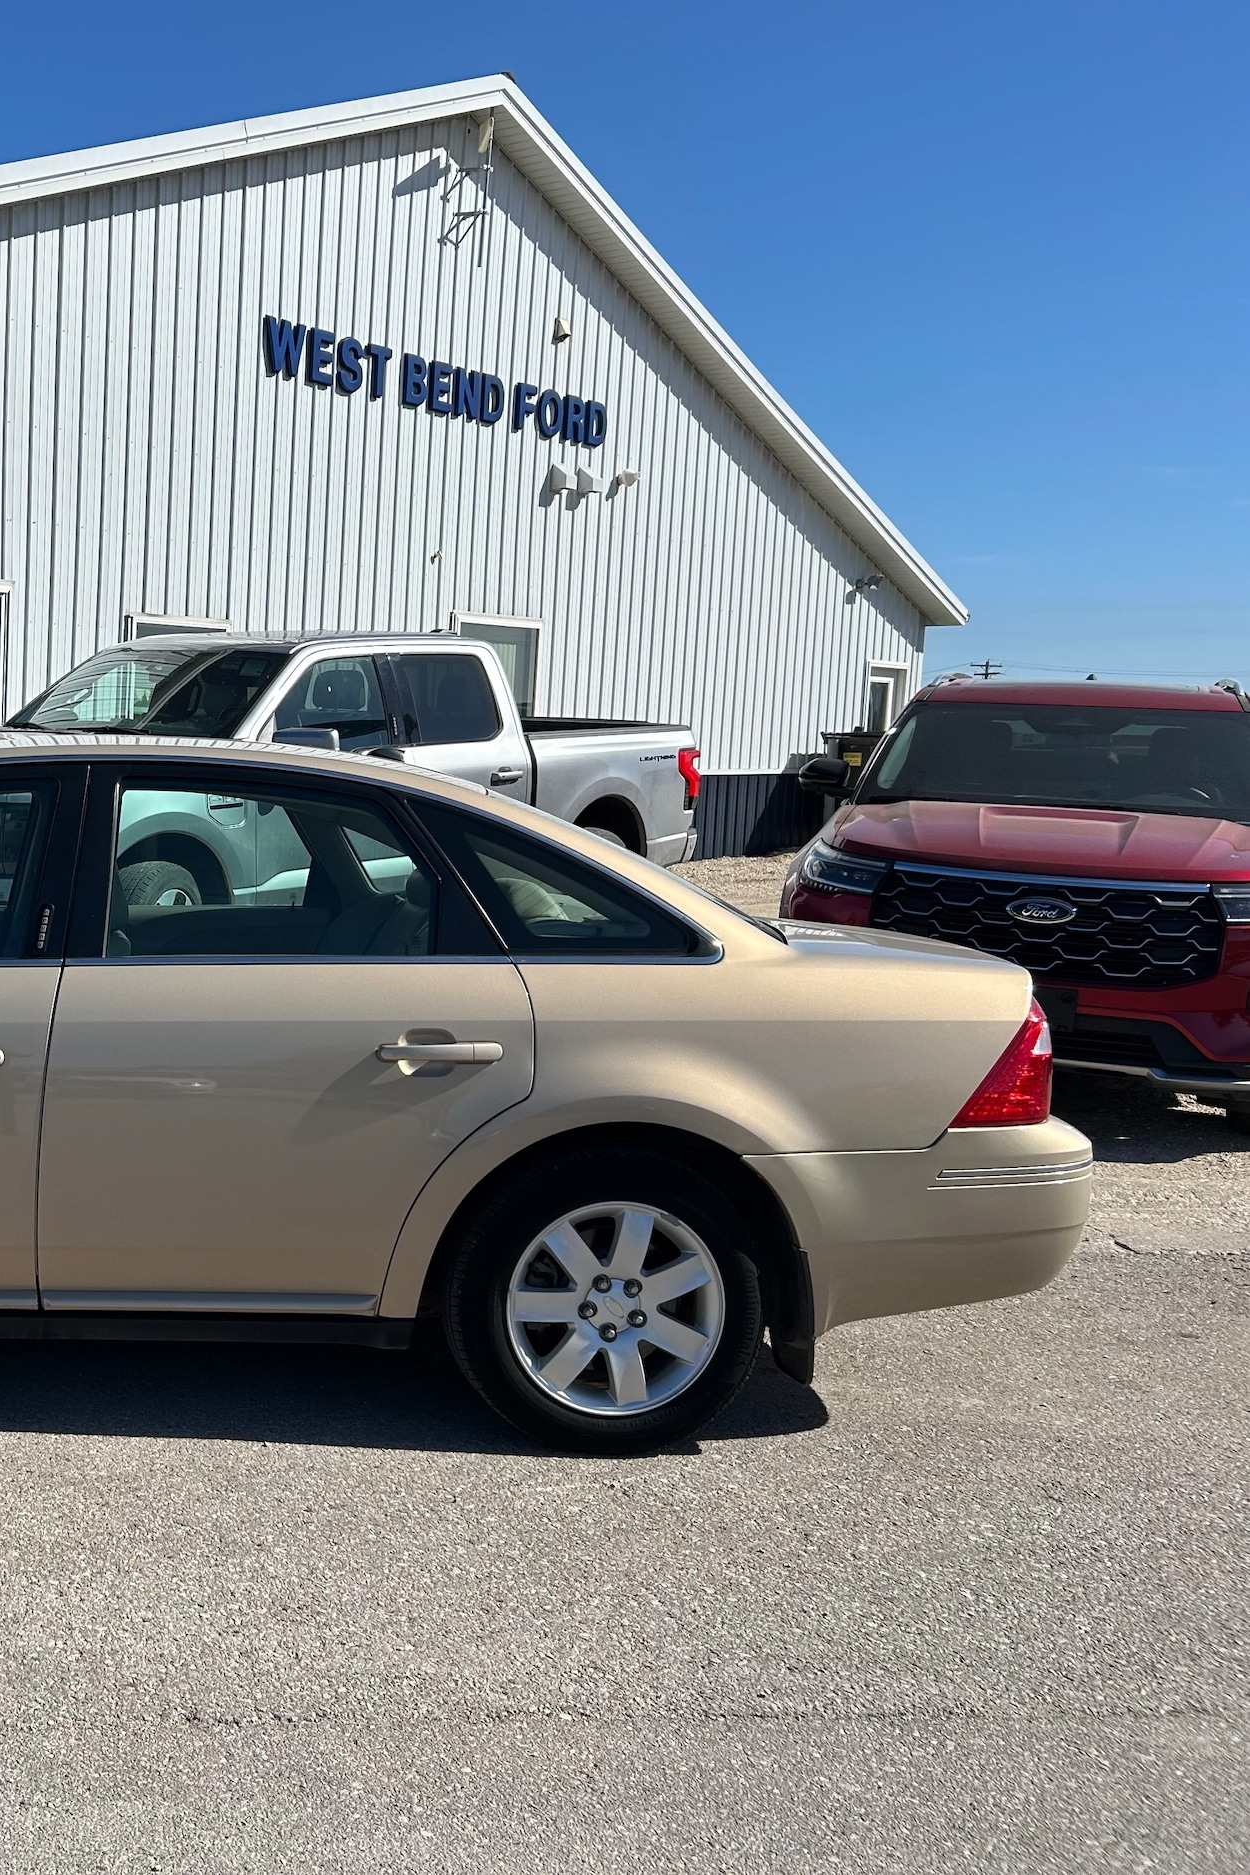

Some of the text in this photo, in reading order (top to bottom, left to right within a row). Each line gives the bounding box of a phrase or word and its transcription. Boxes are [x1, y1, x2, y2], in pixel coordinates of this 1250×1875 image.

[263, 314, 608, 448] WEST BEND FORD
[639, 754, 677, 762] LIGHTNING
[1021, 903, 1060, 918] Ford
